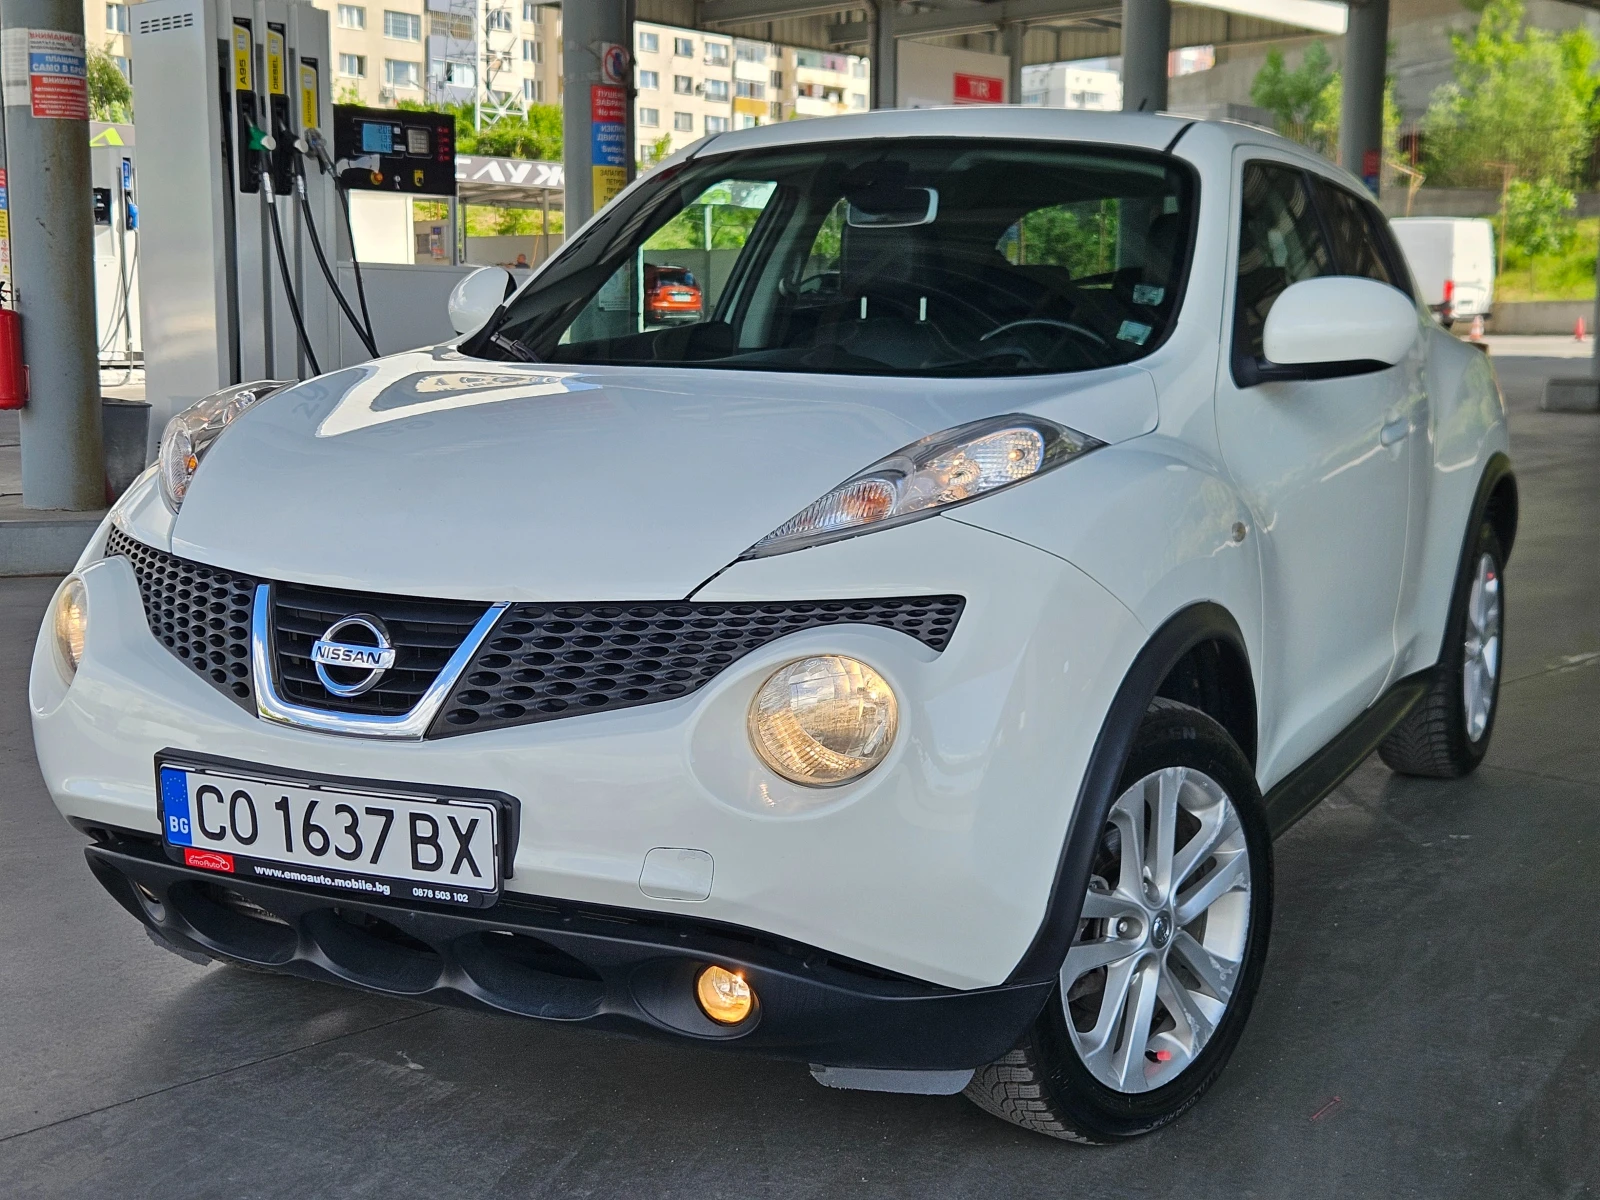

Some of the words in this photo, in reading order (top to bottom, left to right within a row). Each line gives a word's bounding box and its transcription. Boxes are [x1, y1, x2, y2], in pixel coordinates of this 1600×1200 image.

[32, 63, 60, 72] САМО
[62, 64, 69, 73] В
[239, 59, 247, 85] A95
[968, 80, 990, 98] TIR
[315, 645, 382, 665] NISSAN
[169, 816, 189, 834] BG
[275, 795, 395, 865] 1637
[409, 812, 483, 878] BX
[254, 865, 391, 895] www.emoauto.mobile.bg
[412, 887, 434, 899] 0878
[434, 889, 452, 901] 503
[453, 892, 469, 903] 102
